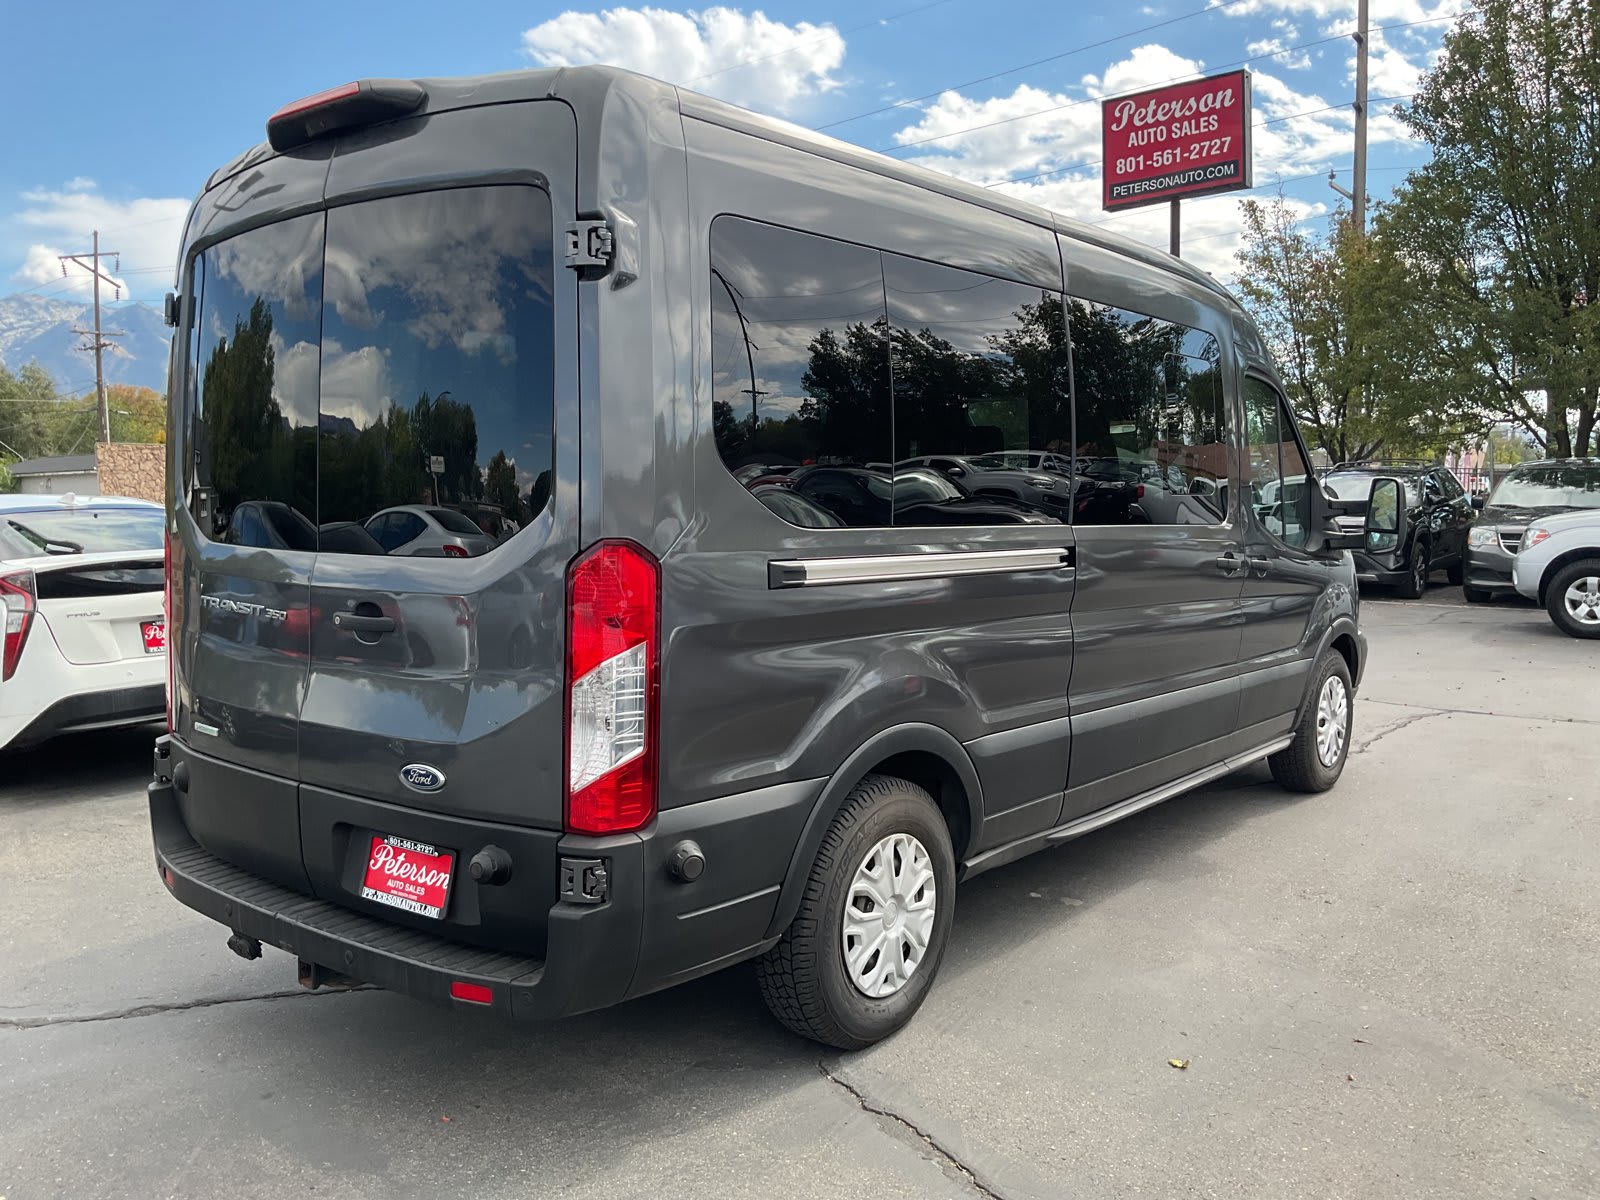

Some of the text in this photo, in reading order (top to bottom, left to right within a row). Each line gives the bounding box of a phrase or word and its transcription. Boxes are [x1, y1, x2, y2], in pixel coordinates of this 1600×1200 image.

[1111, 88, 1235, 131] Peterson
[1128, 115, 1219, 147] AUTO SALES
[1116, 136, 1232, 174] 801-561-2727
[1113, 163, 1234, 197] PETERSONAUTO.COM
[200, 595, 287, 620] TRANSIT 350
[408, 769, 432, 785] Ford
[370, 844, 449, 889] Peterson
[387, 879, 404, 890] AUTO
[405, 883, 426, 896] SALES
